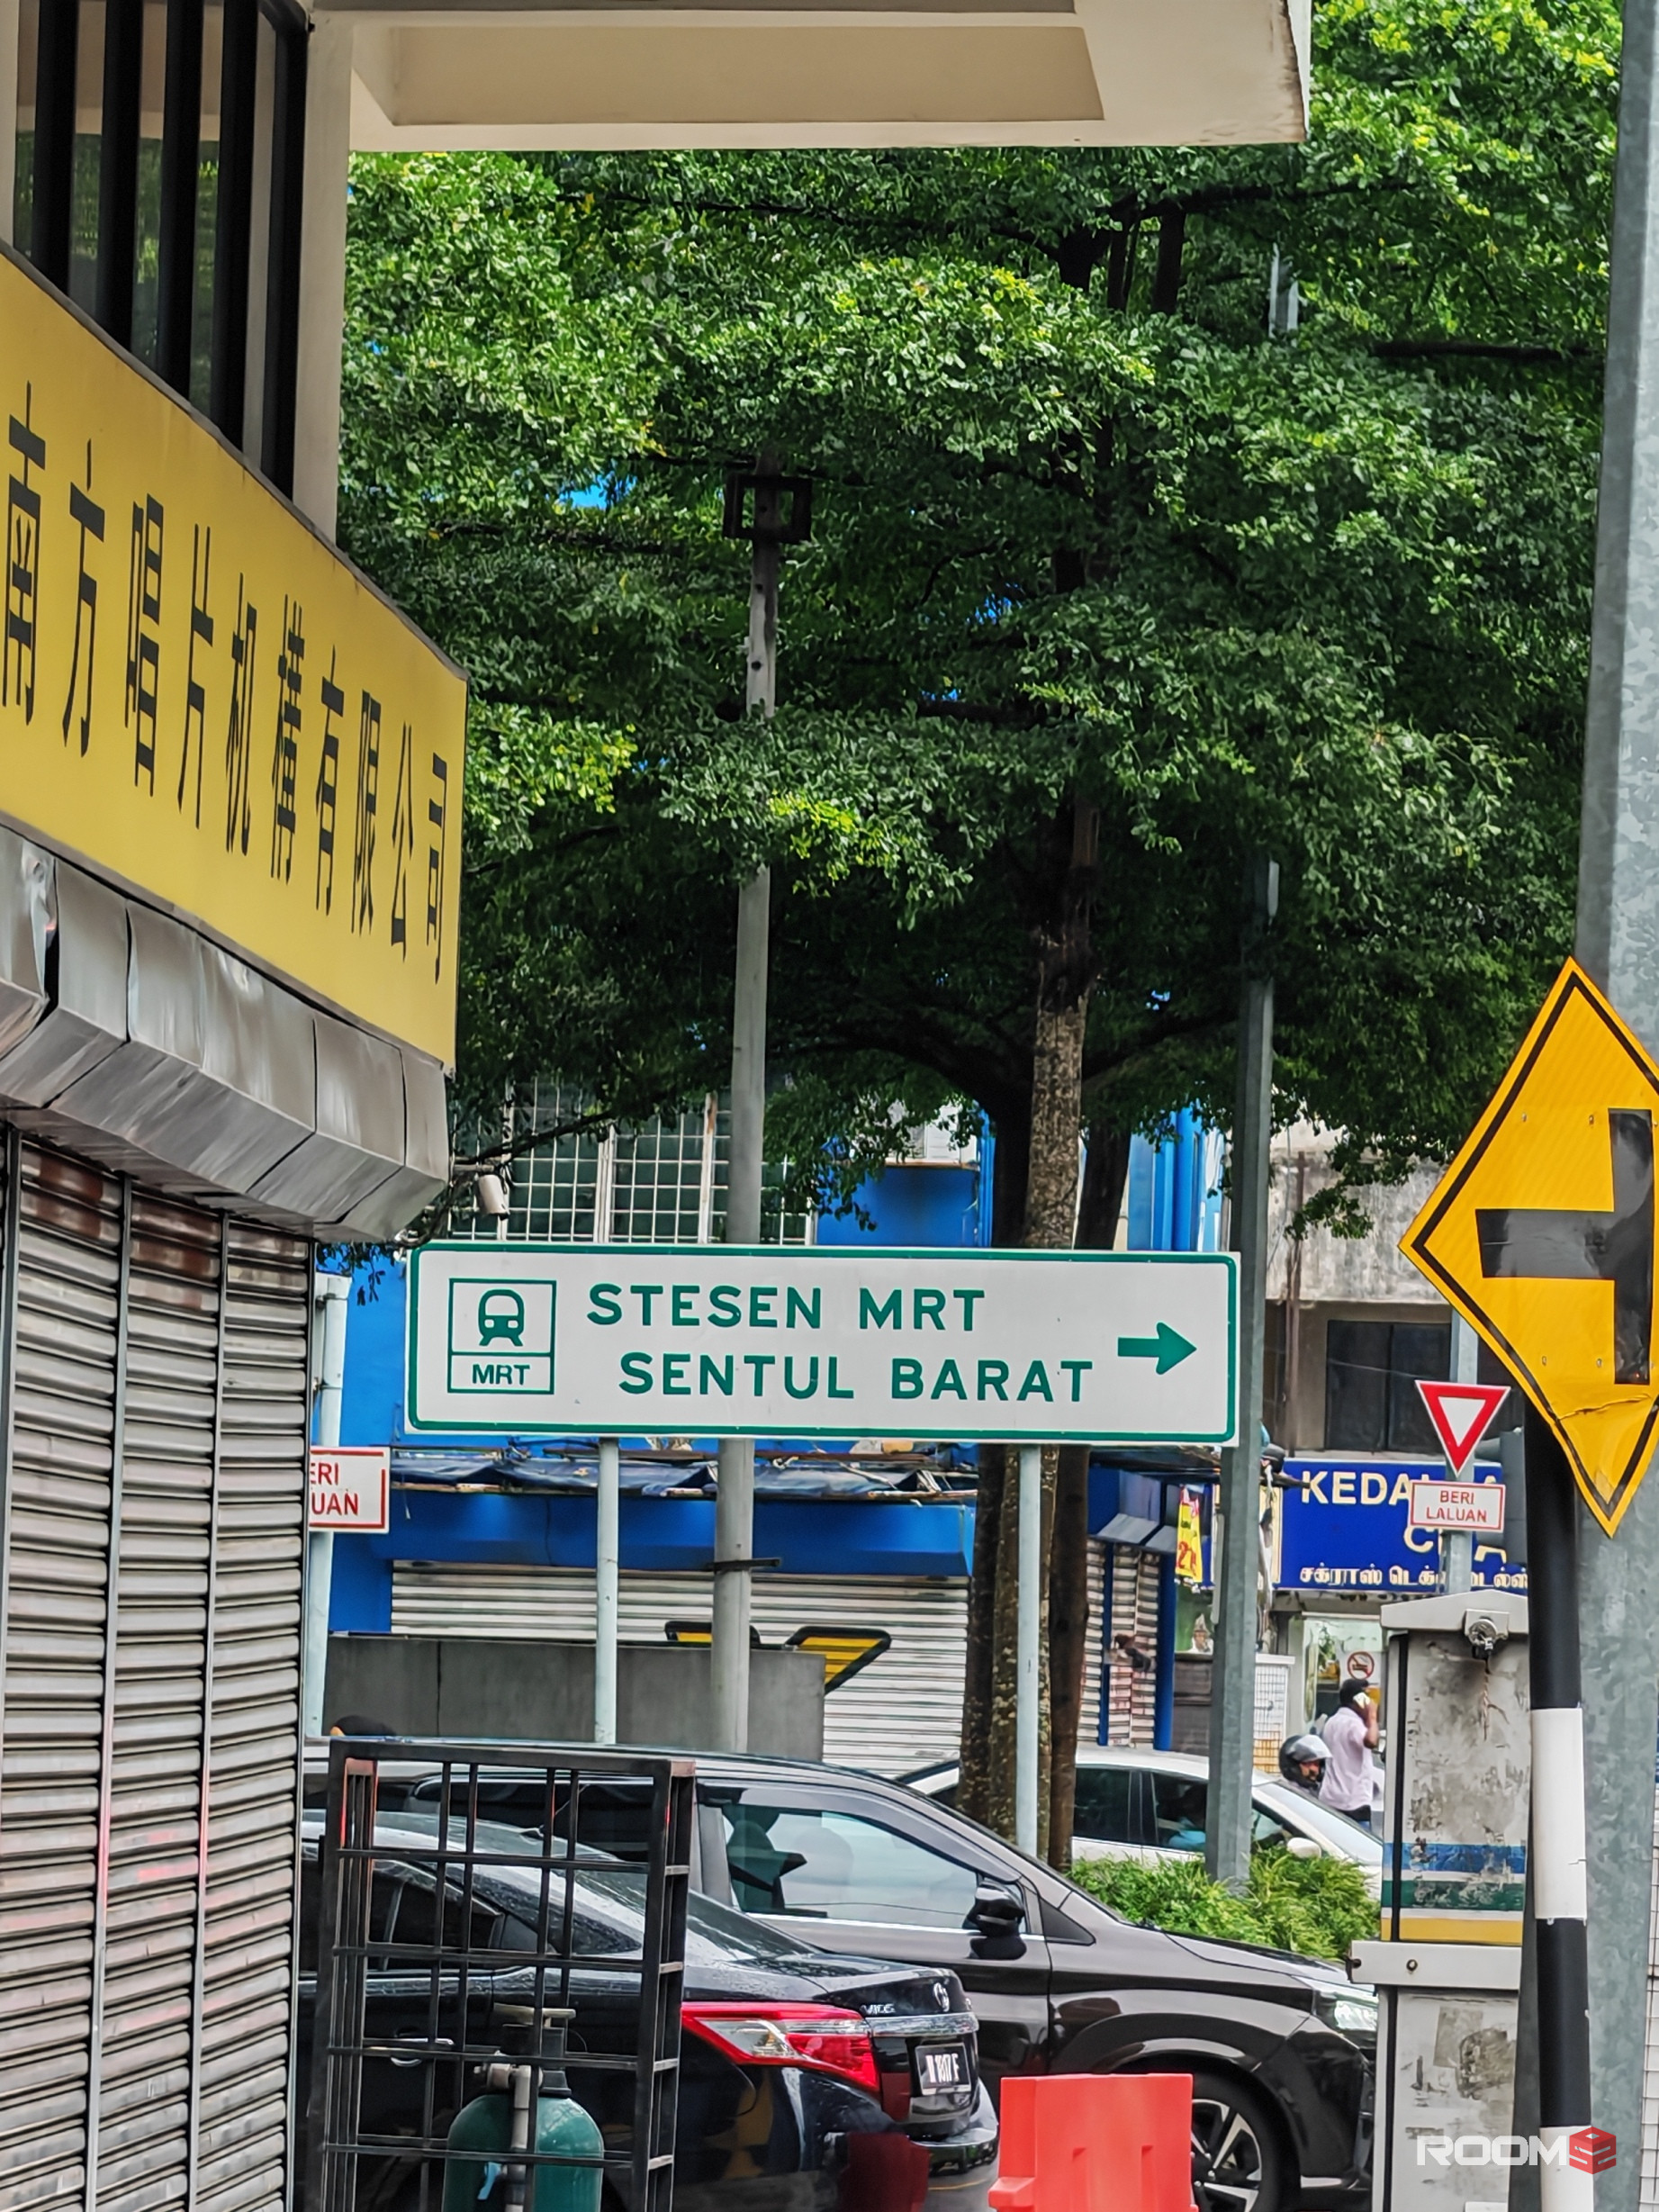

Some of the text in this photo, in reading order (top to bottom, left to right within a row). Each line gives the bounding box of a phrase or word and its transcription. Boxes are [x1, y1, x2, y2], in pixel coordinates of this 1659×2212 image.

[587, 1283, 985, 1331] STESEN MRT
[472, 1364, 530, 1386] MRT
[619, 1352, 1093, 1403] SENTUL BARAT
[1302, 1470, 1429, 1506] KEDA
[1440, 1490, 1475, 1505] BERI
[1426, 1506, 1487, 1523] LALUAN
